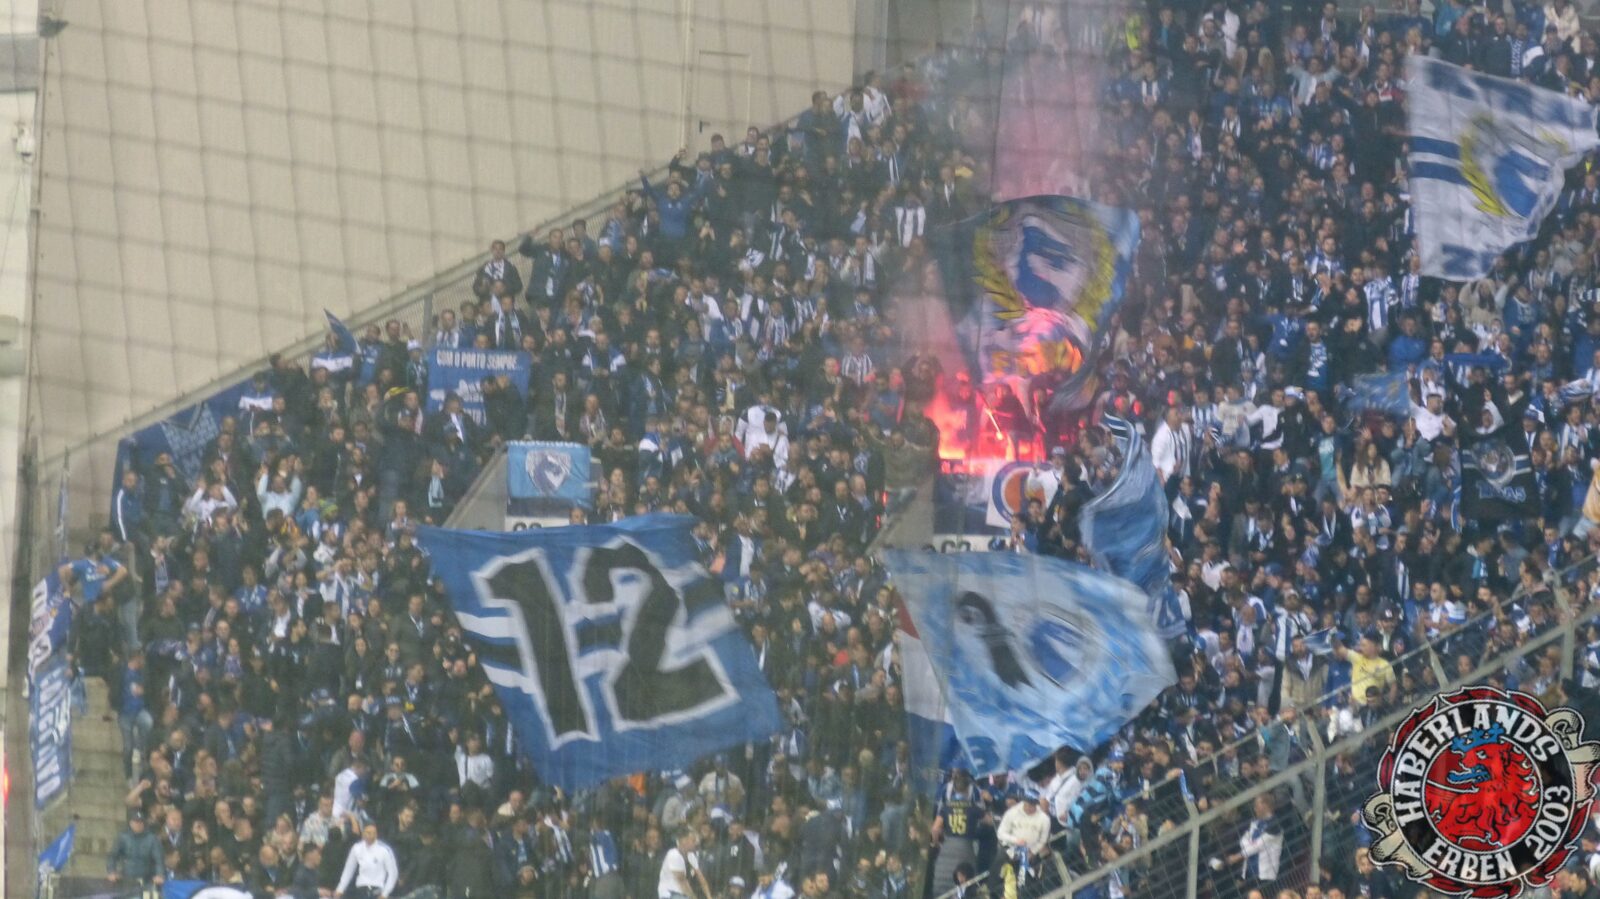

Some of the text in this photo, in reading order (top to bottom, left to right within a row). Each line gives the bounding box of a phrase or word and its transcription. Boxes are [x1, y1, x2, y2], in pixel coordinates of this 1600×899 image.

[436, 350, 453, 366] COM
[454, 352, 460, 368] O
[461, 352, 486, 369] PORTO
[472, 536, 740, 750] 12
